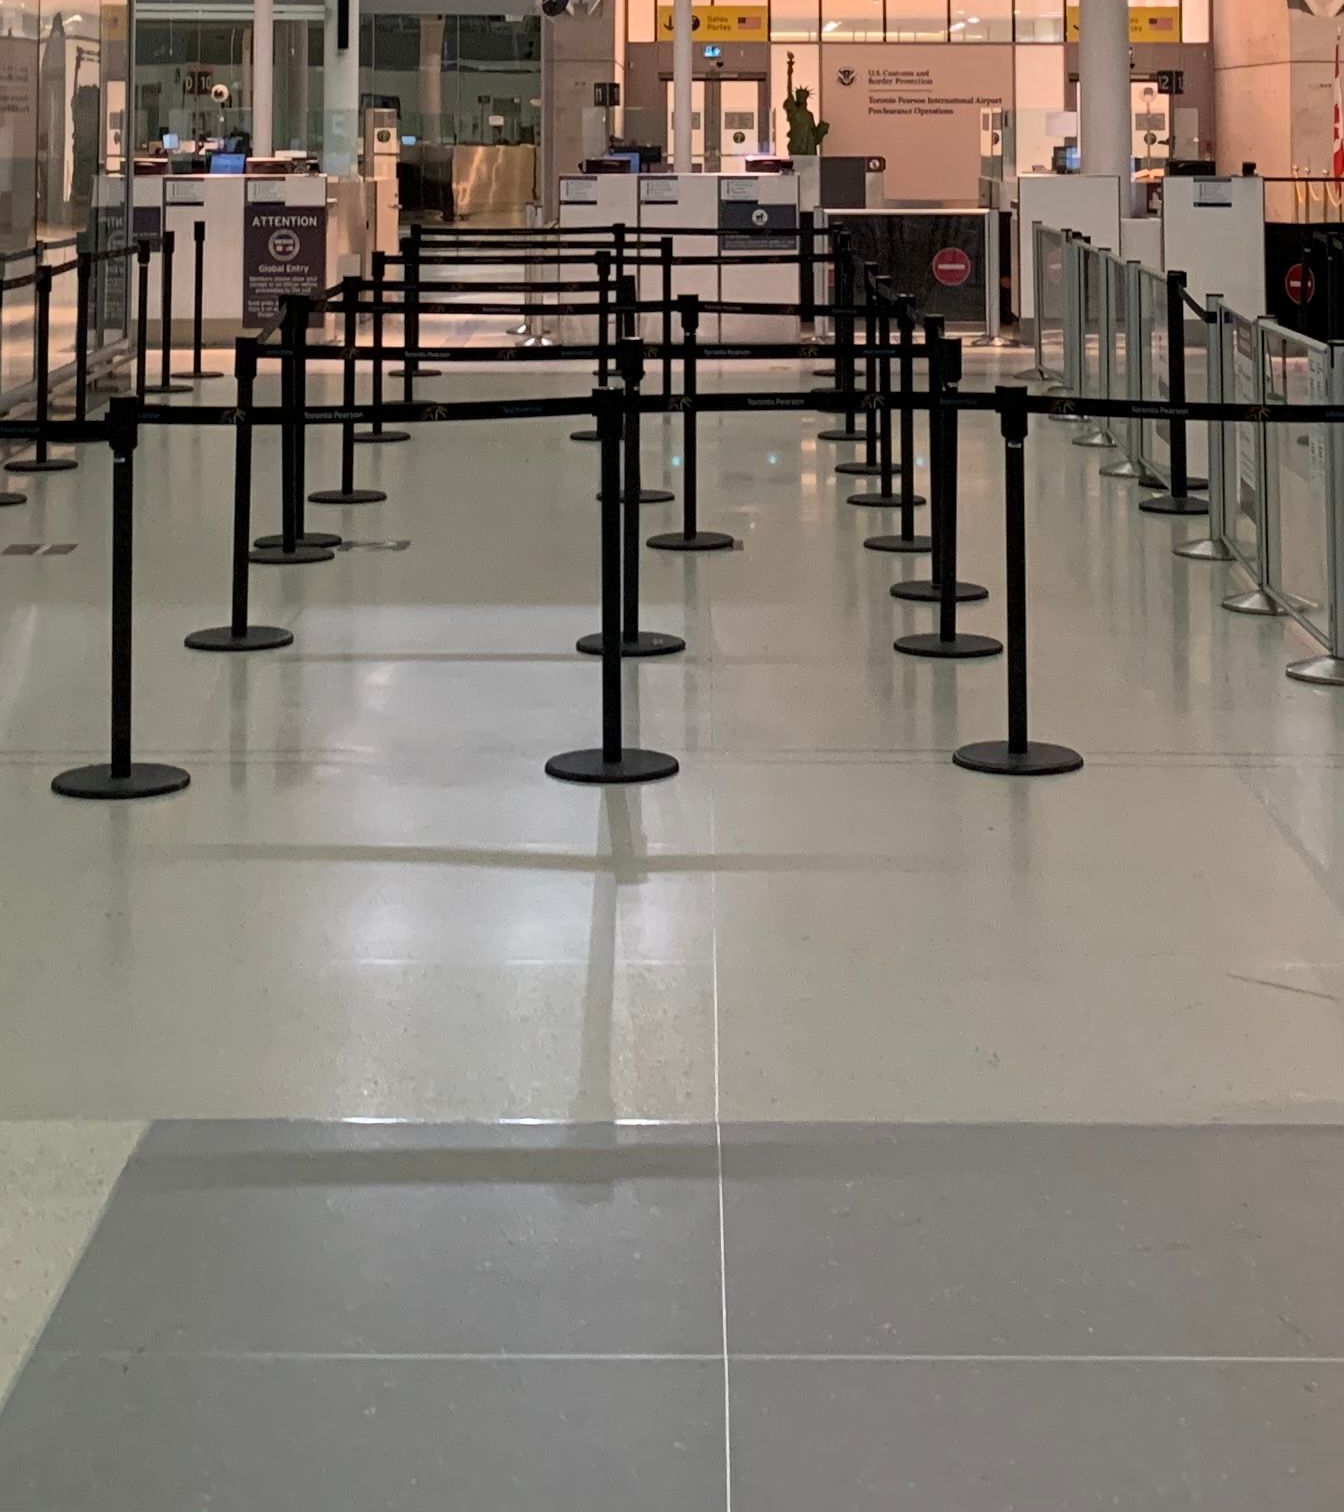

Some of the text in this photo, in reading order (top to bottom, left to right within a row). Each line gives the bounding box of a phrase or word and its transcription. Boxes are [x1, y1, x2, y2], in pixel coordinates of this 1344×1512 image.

[975, 97, 1002, 106] Airport
[252, 215, 318, 227] ATTENTION
[258, 264, 309, 274] Global Entry
